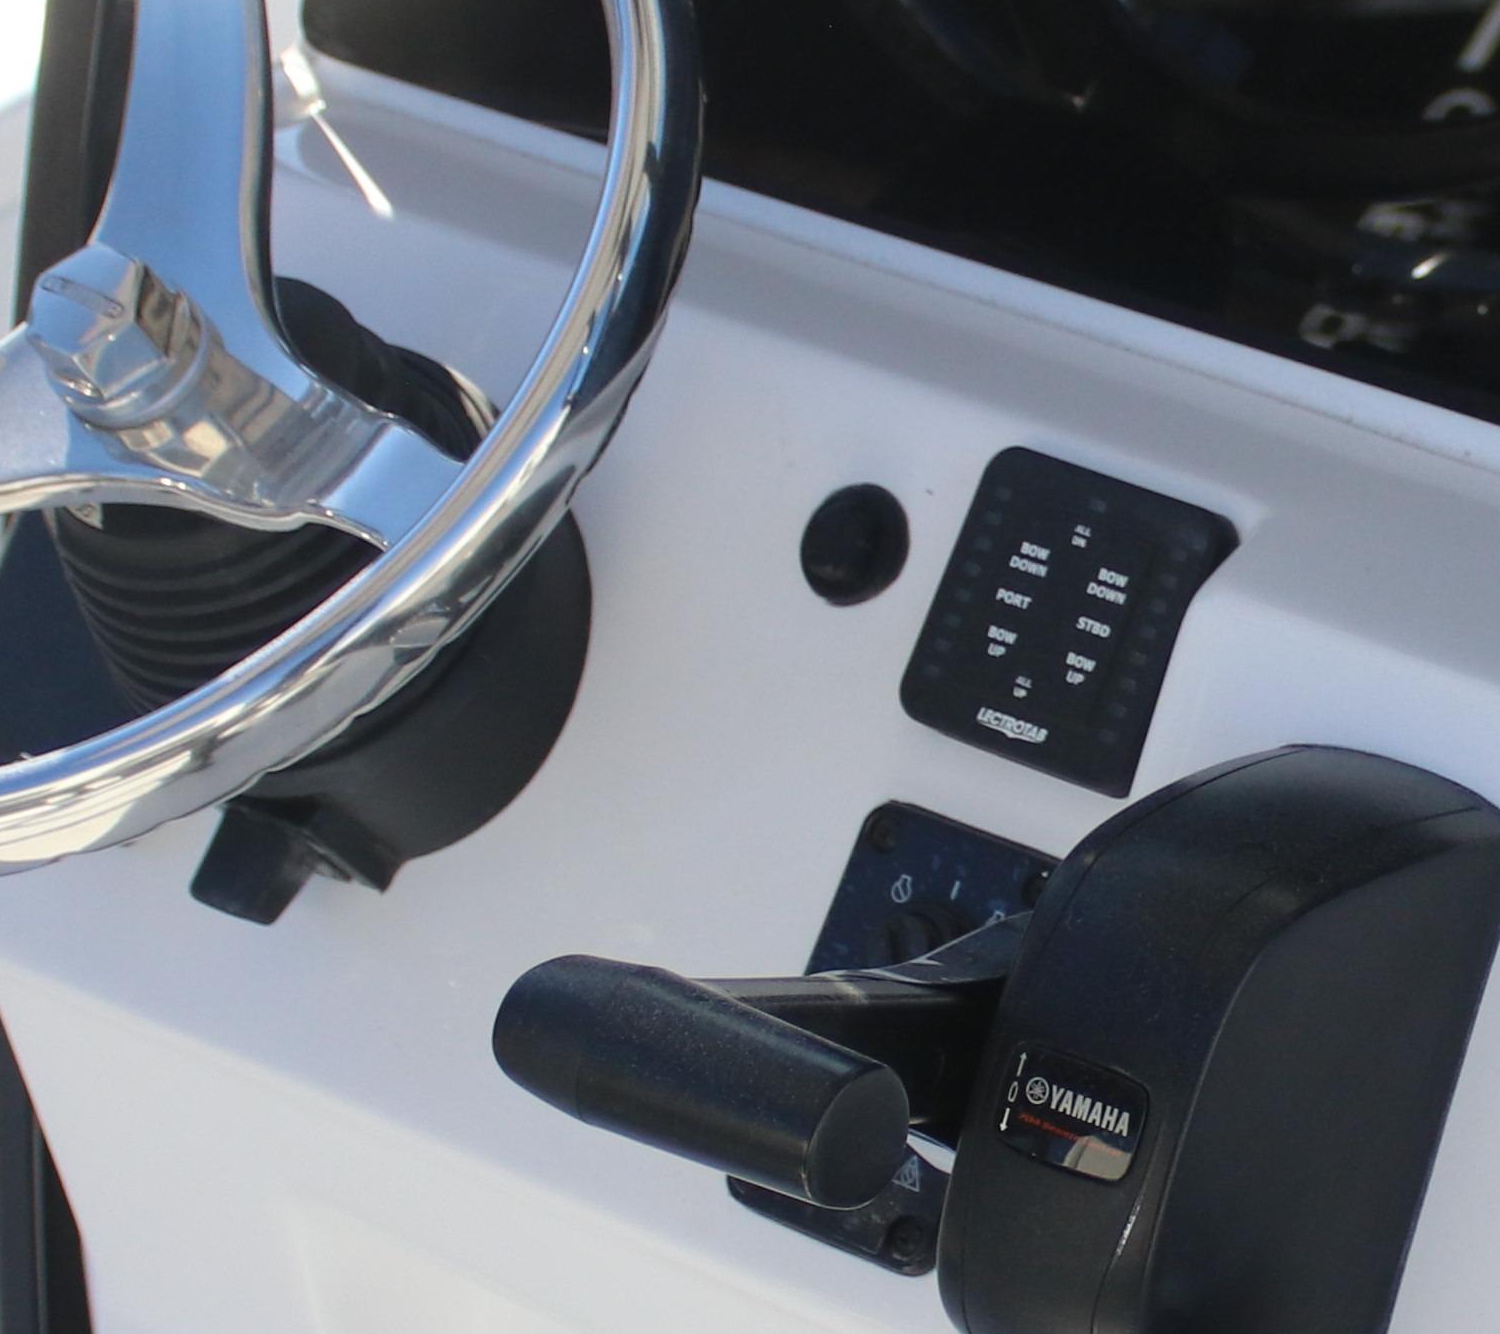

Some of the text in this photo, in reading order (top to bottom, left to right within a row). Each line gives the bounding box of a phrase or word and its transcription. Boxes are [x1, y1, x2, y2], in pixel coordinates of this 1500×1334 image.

[1074, 524, 1092, 537] ALL
[1020, 541, 1050, 561] BOW
[1009, 555, 1048, 578] DOWN
[1098, 568, 1129, 588] BOW
[996, 588, 1032, 610] PORT
[1087, 582, 1127, 605] DOWN
[987, 625, 1018, 645] BOW
[1076, 616, 1112, 638] STBD
[987, 643, 1006, 657] UP
[1066, 651, 1096, 672] BOW
[1065, 670, 1085, 685] UP
[1013, 686, 1028, 698] UP
[976, 706, 1049, 743] LECTROTAB
[1050, 1084, 1130, 1137] YAMAHA
